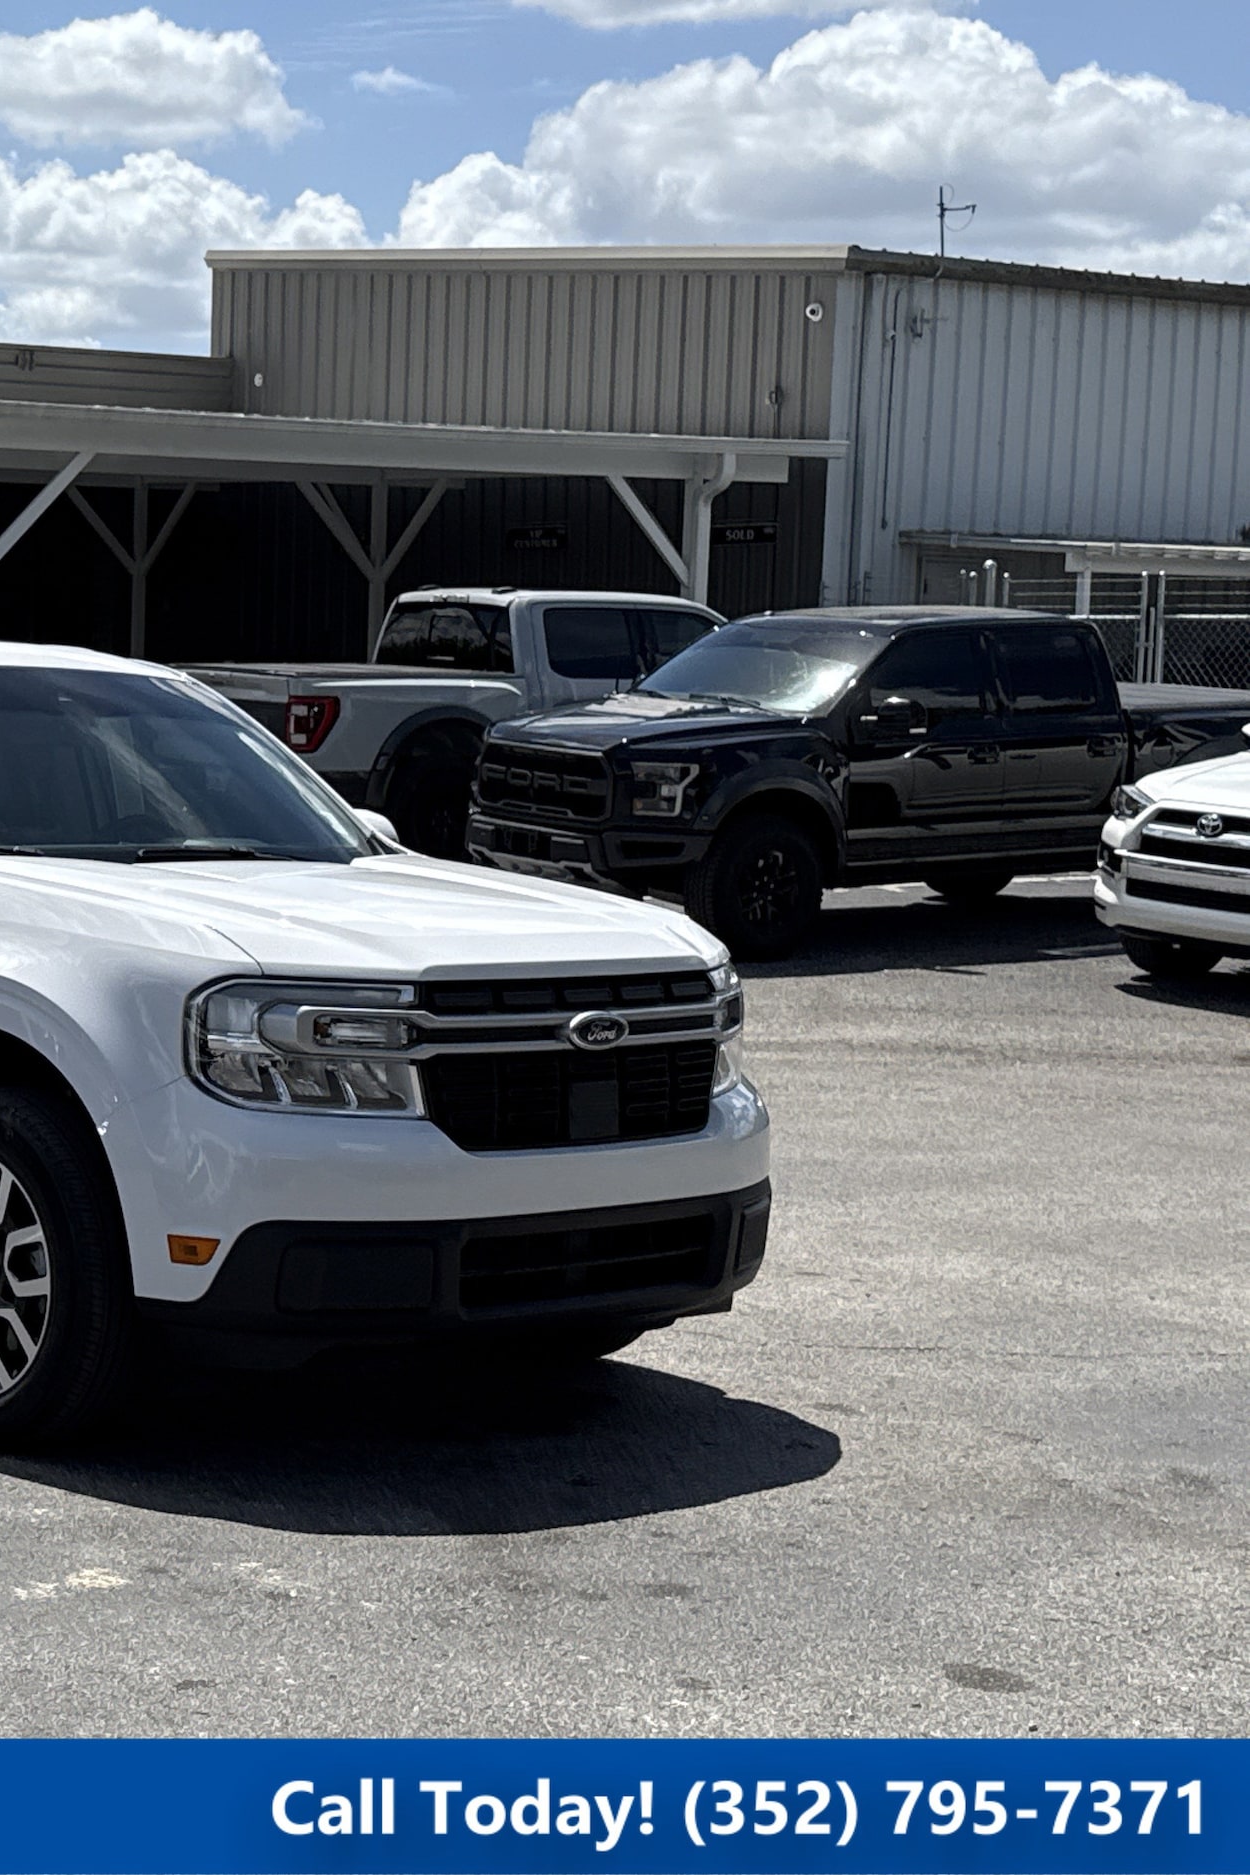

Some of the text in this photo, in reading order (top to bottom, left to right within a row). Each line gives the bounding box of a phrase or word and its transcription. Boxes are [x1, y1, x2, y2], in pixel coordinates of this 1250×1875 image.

[725, 529, 755, 541] SOLD
[481, 762, 599, 795] FORD
[587, 1021, 618, 1041] Ford
